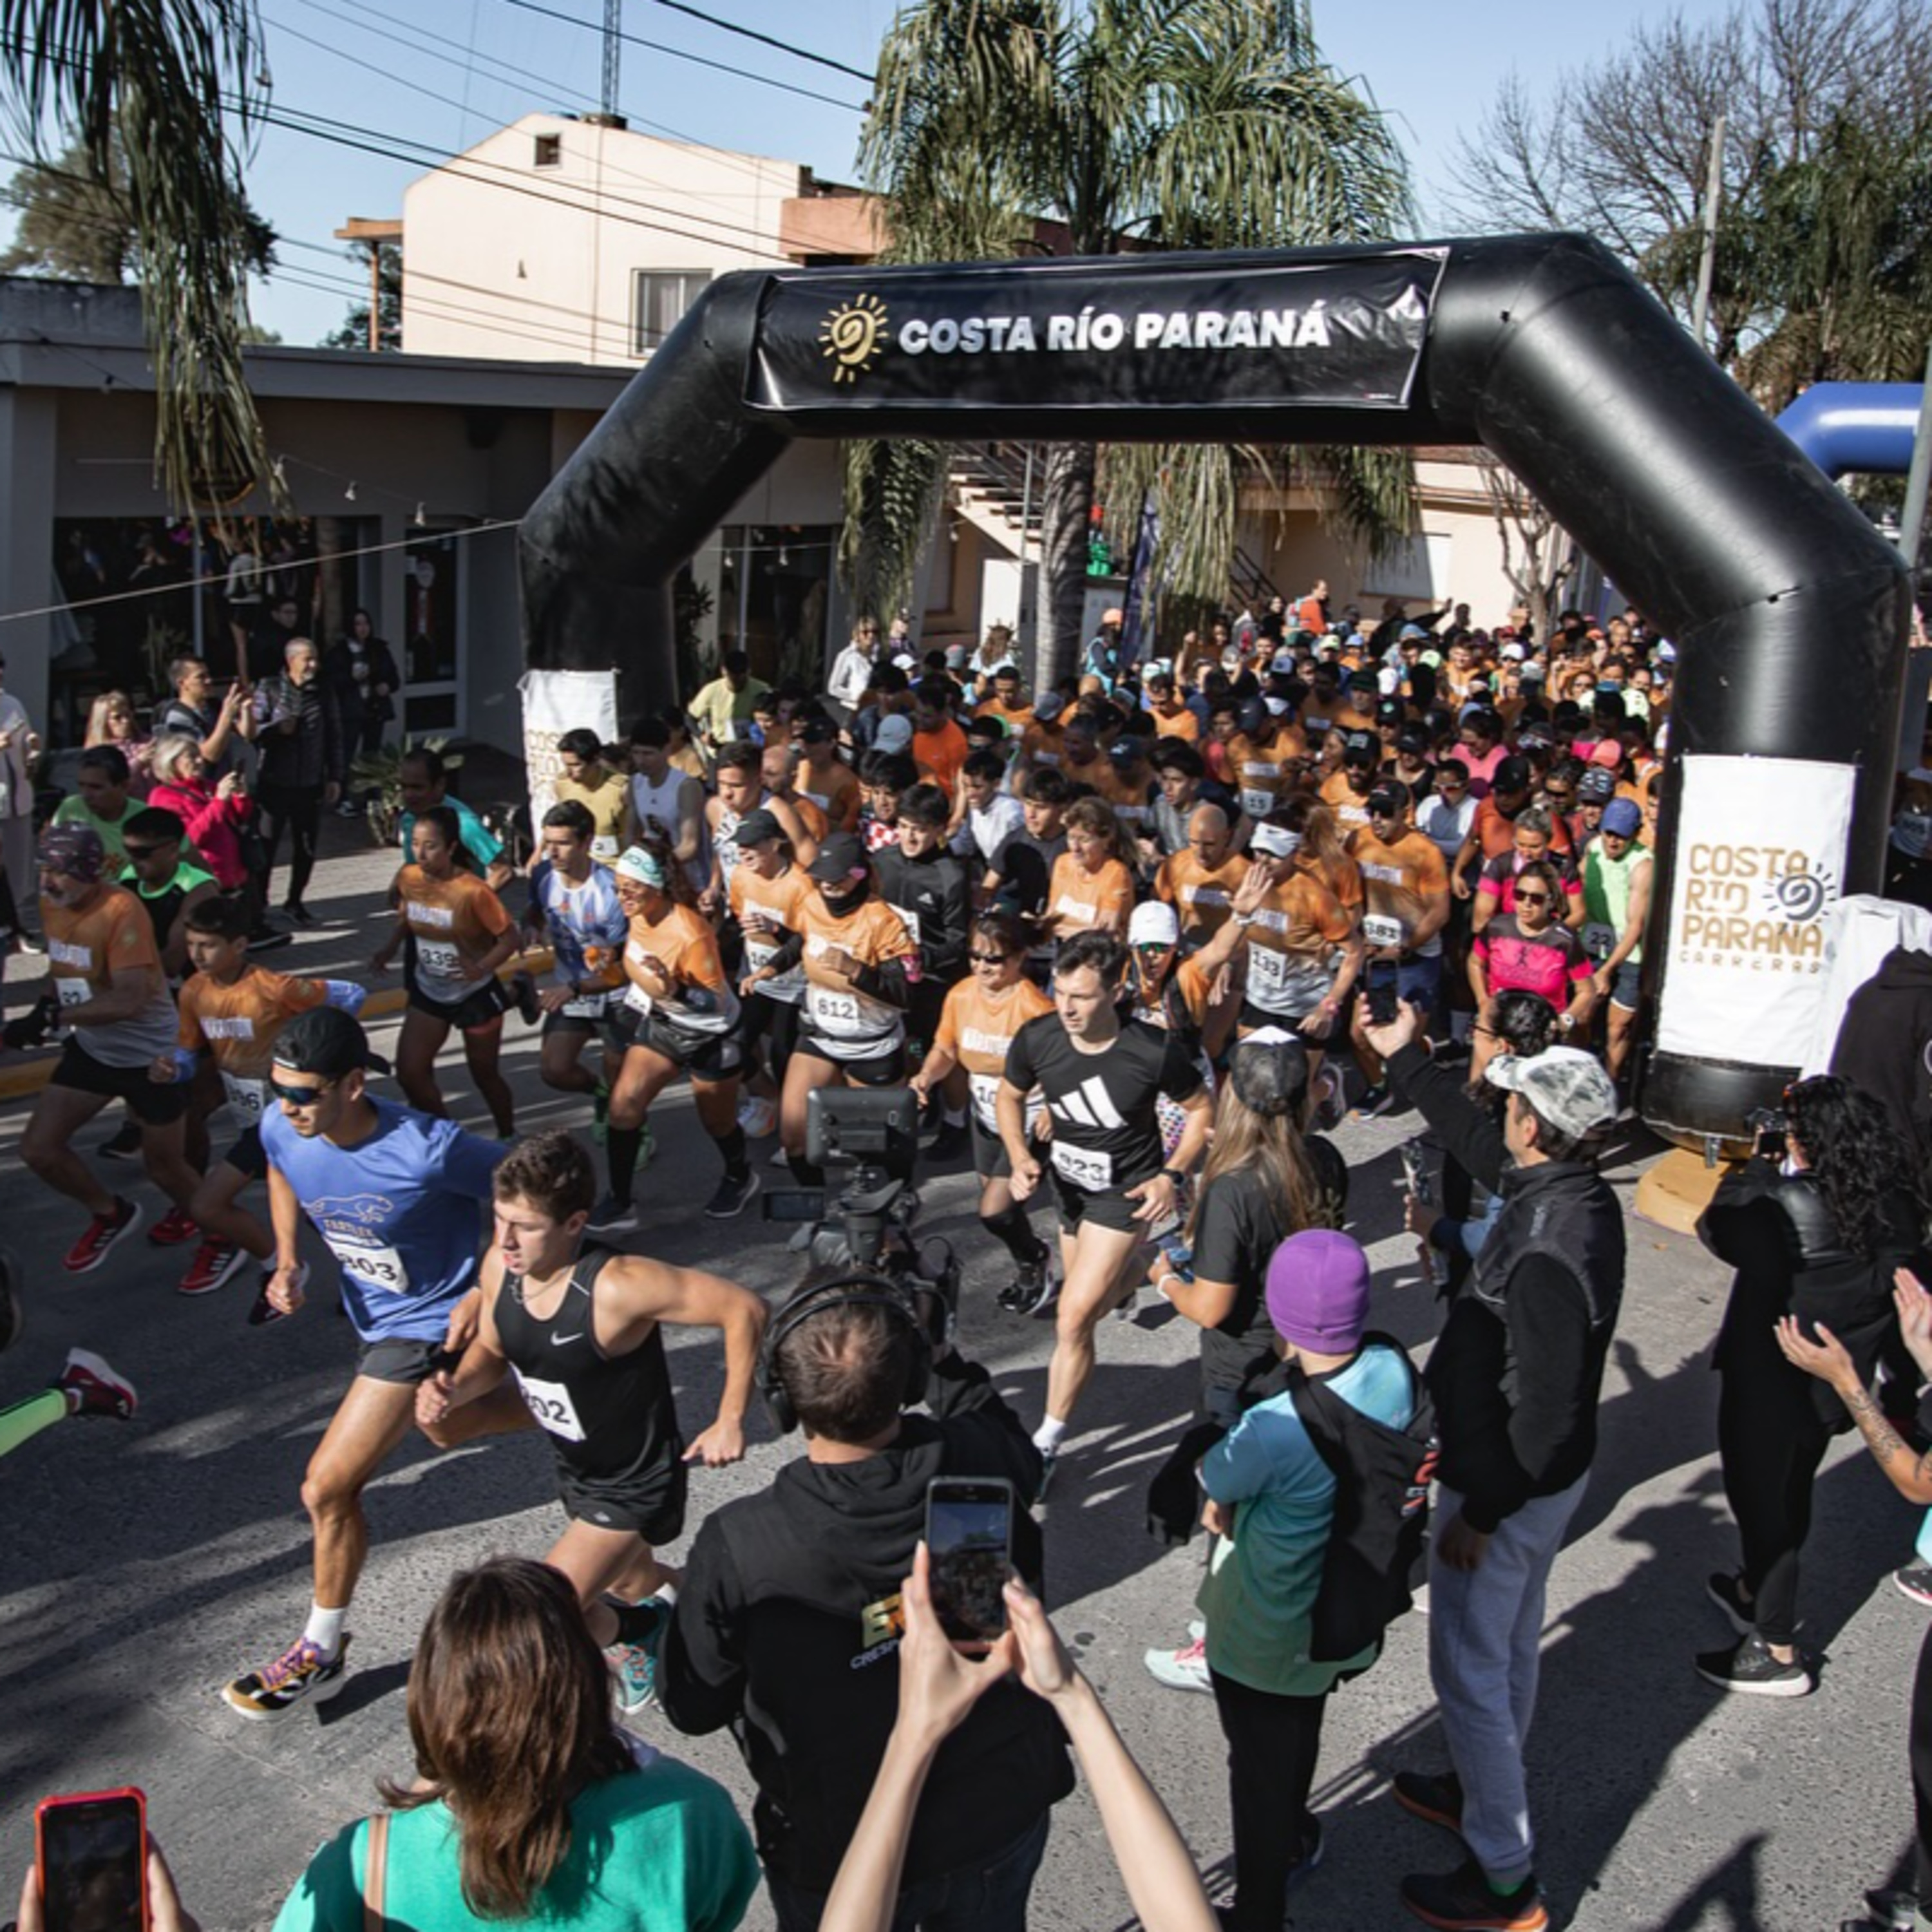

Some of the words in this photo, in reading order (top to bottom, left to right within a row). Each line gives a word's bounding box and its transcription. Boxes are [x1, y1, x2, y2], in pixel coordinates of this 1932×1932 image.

[900, 315, 1037, 355] COSTA
[1046, 306, 1127, 351] RÍO
[1134, 300, 1331, 349] PARANÁ
[1689, 843, 1809, 883] COSTA
